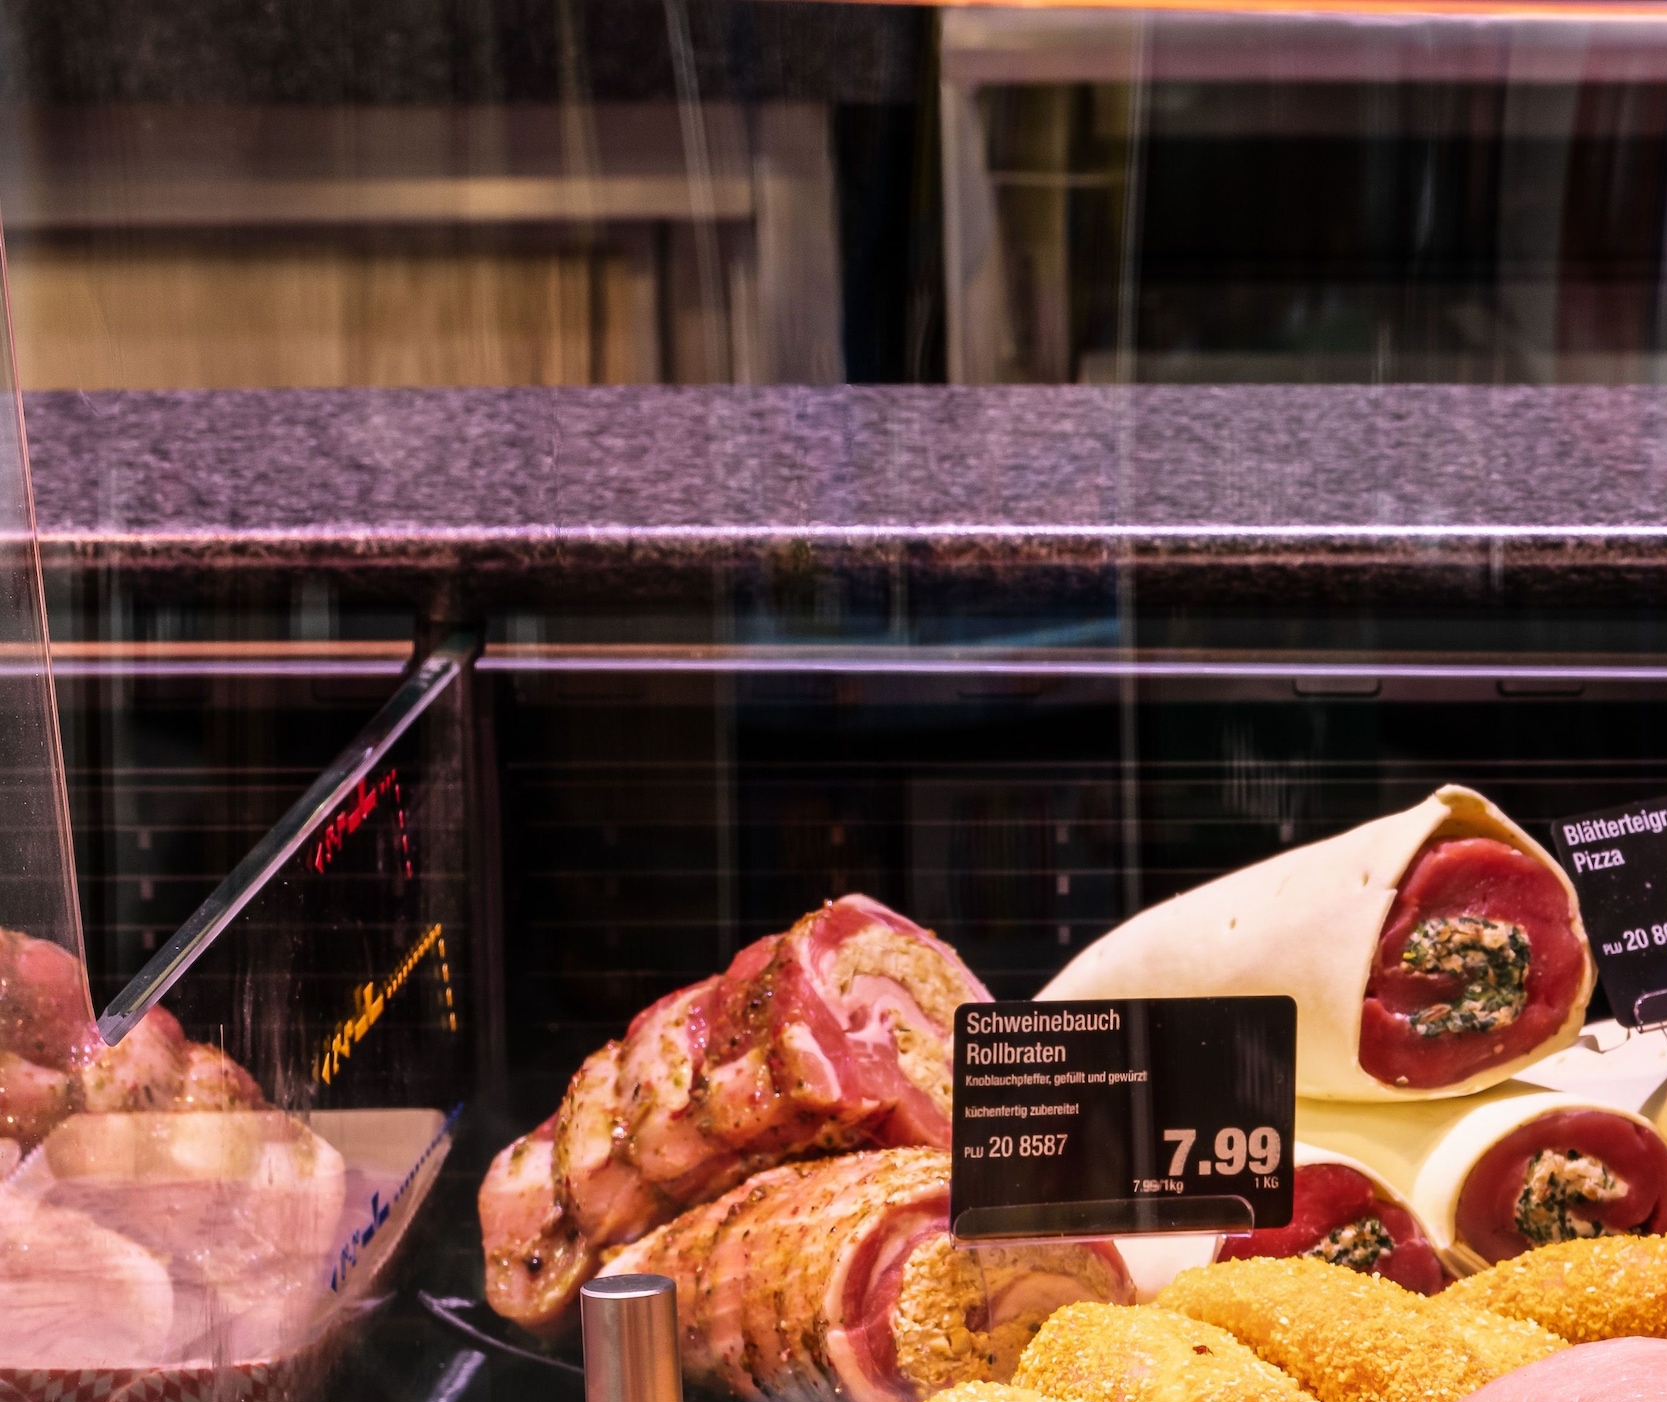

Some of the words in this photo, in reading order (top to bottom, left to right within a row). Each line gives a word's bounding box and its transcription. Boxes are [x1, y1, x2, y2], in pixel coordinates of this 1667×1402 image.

[1572, 849, 1625, 873] Pizza
[1602, 942, 1623, 955] PLU
[1623, 928, 1649, 951] 20
[967, 1009, 1120, 1034] Schweinebauch
[967, 1042, 1066, 1065] Rollbraten
[966, 1073, 1052, 1087] Knoblauchpfeffer,
[1054, 1072, 1085, 1086] gefüllt
[1088, 1071, 1106, 1083] und
[1108, 1070, 1147, 1085] gewürzt
[965, 1105, 1028, 1119] küchenfertig
[1030, 1103, 1079, 1116] zubereitet
[964, 1146, 984, 1158] PLU
[989, 1136, 1013, 1157] 20
[1019, 1134, 1068, 1157] 8587
[1164, 1126, 1281, 1176] 7.99
[1264, 1176, 1279, 1189] KG
